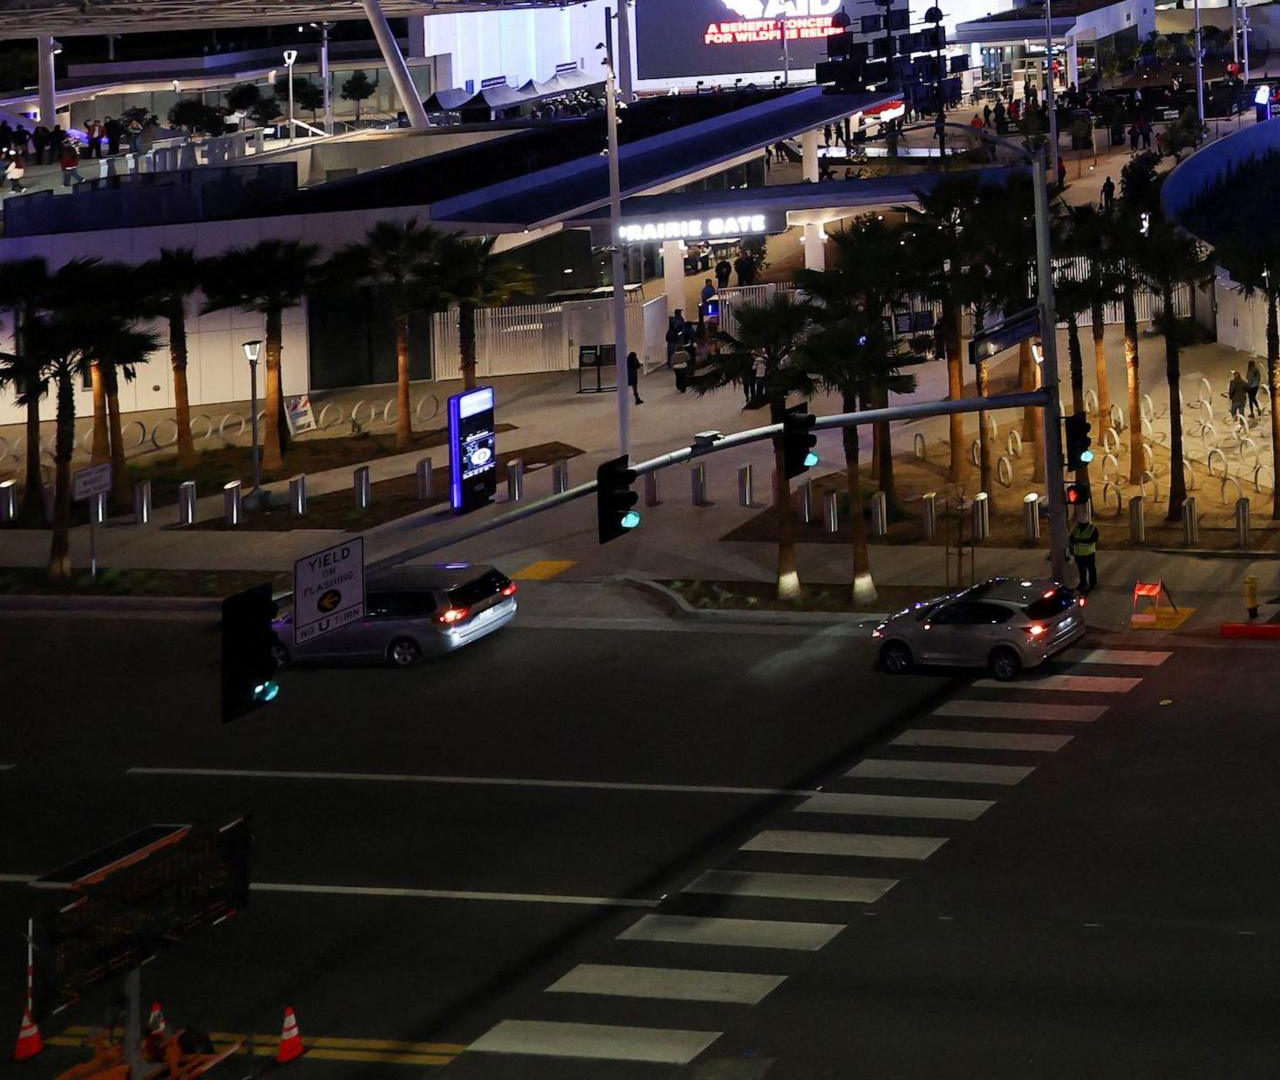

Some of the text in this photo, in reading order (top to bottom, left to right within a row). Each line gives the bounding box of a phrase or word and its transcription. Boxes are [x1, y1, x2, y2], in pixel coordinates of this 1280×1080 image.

[707, 17, 832, 33] A BENEFIT ONCER
[705, 33, 733, 45] FOR
[708, 215, 765, 235] GATE
[309, 548, 350, 571] YIELD
[322, 567, 336, 578] ON
[304, 571, 353, 596] FLASHING
[319, 620, 329, 631] U
